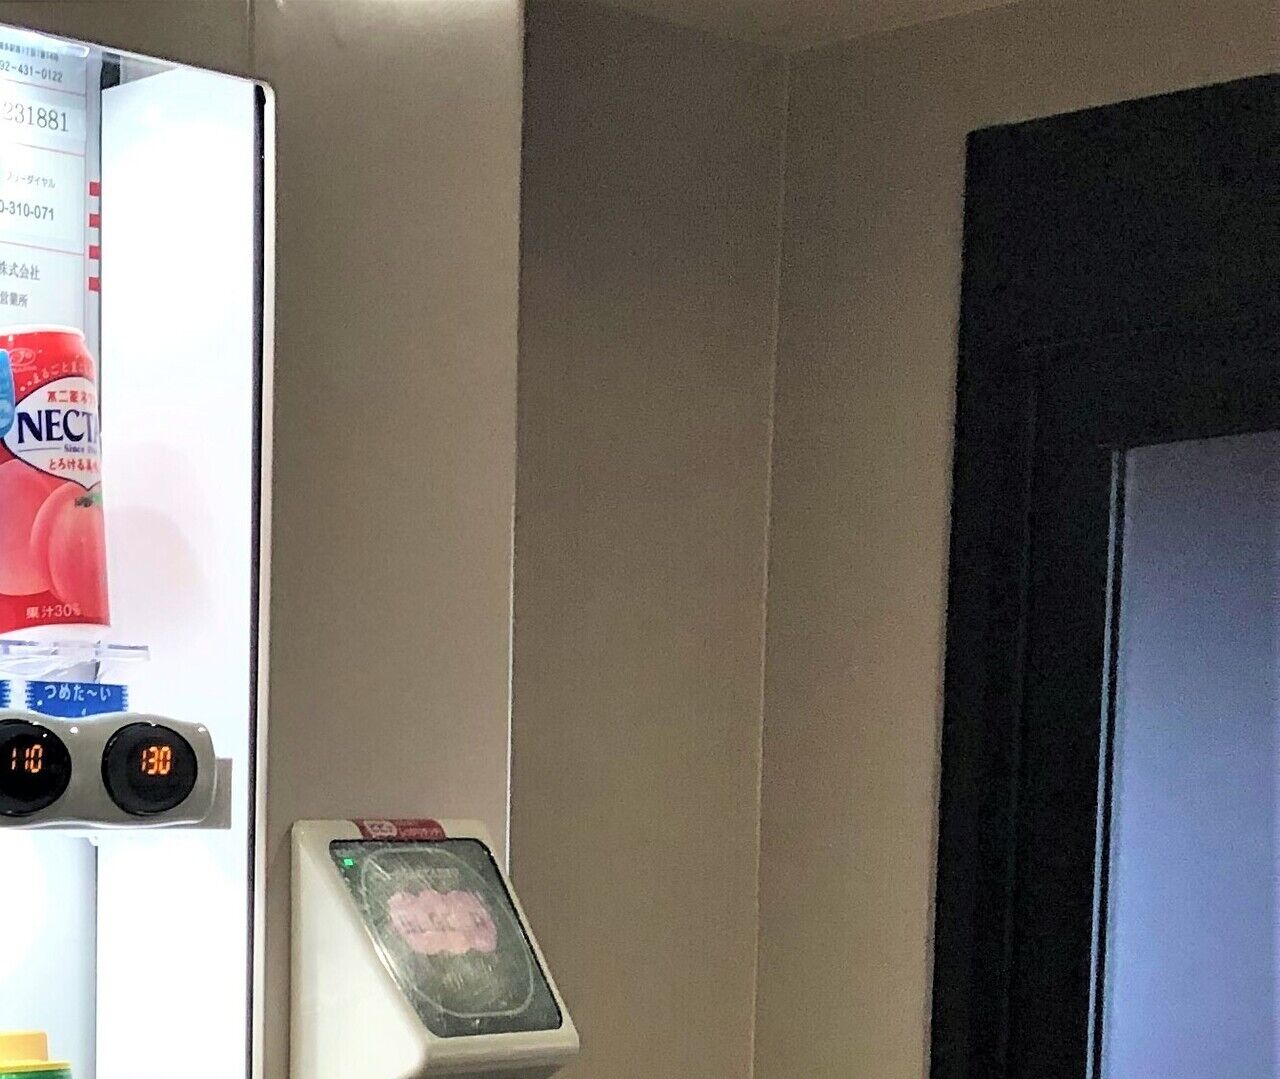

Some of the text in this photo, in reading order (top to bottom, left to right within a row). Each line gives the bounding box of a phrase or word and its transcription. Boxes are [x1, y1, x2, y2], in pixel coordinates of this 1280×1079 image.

[2, 101, 68, 132] 231881
[26, 603, 80, 620] 果汁30%
[10, 745, 43, 774] 110
[140, 746, 172, 776] 130
